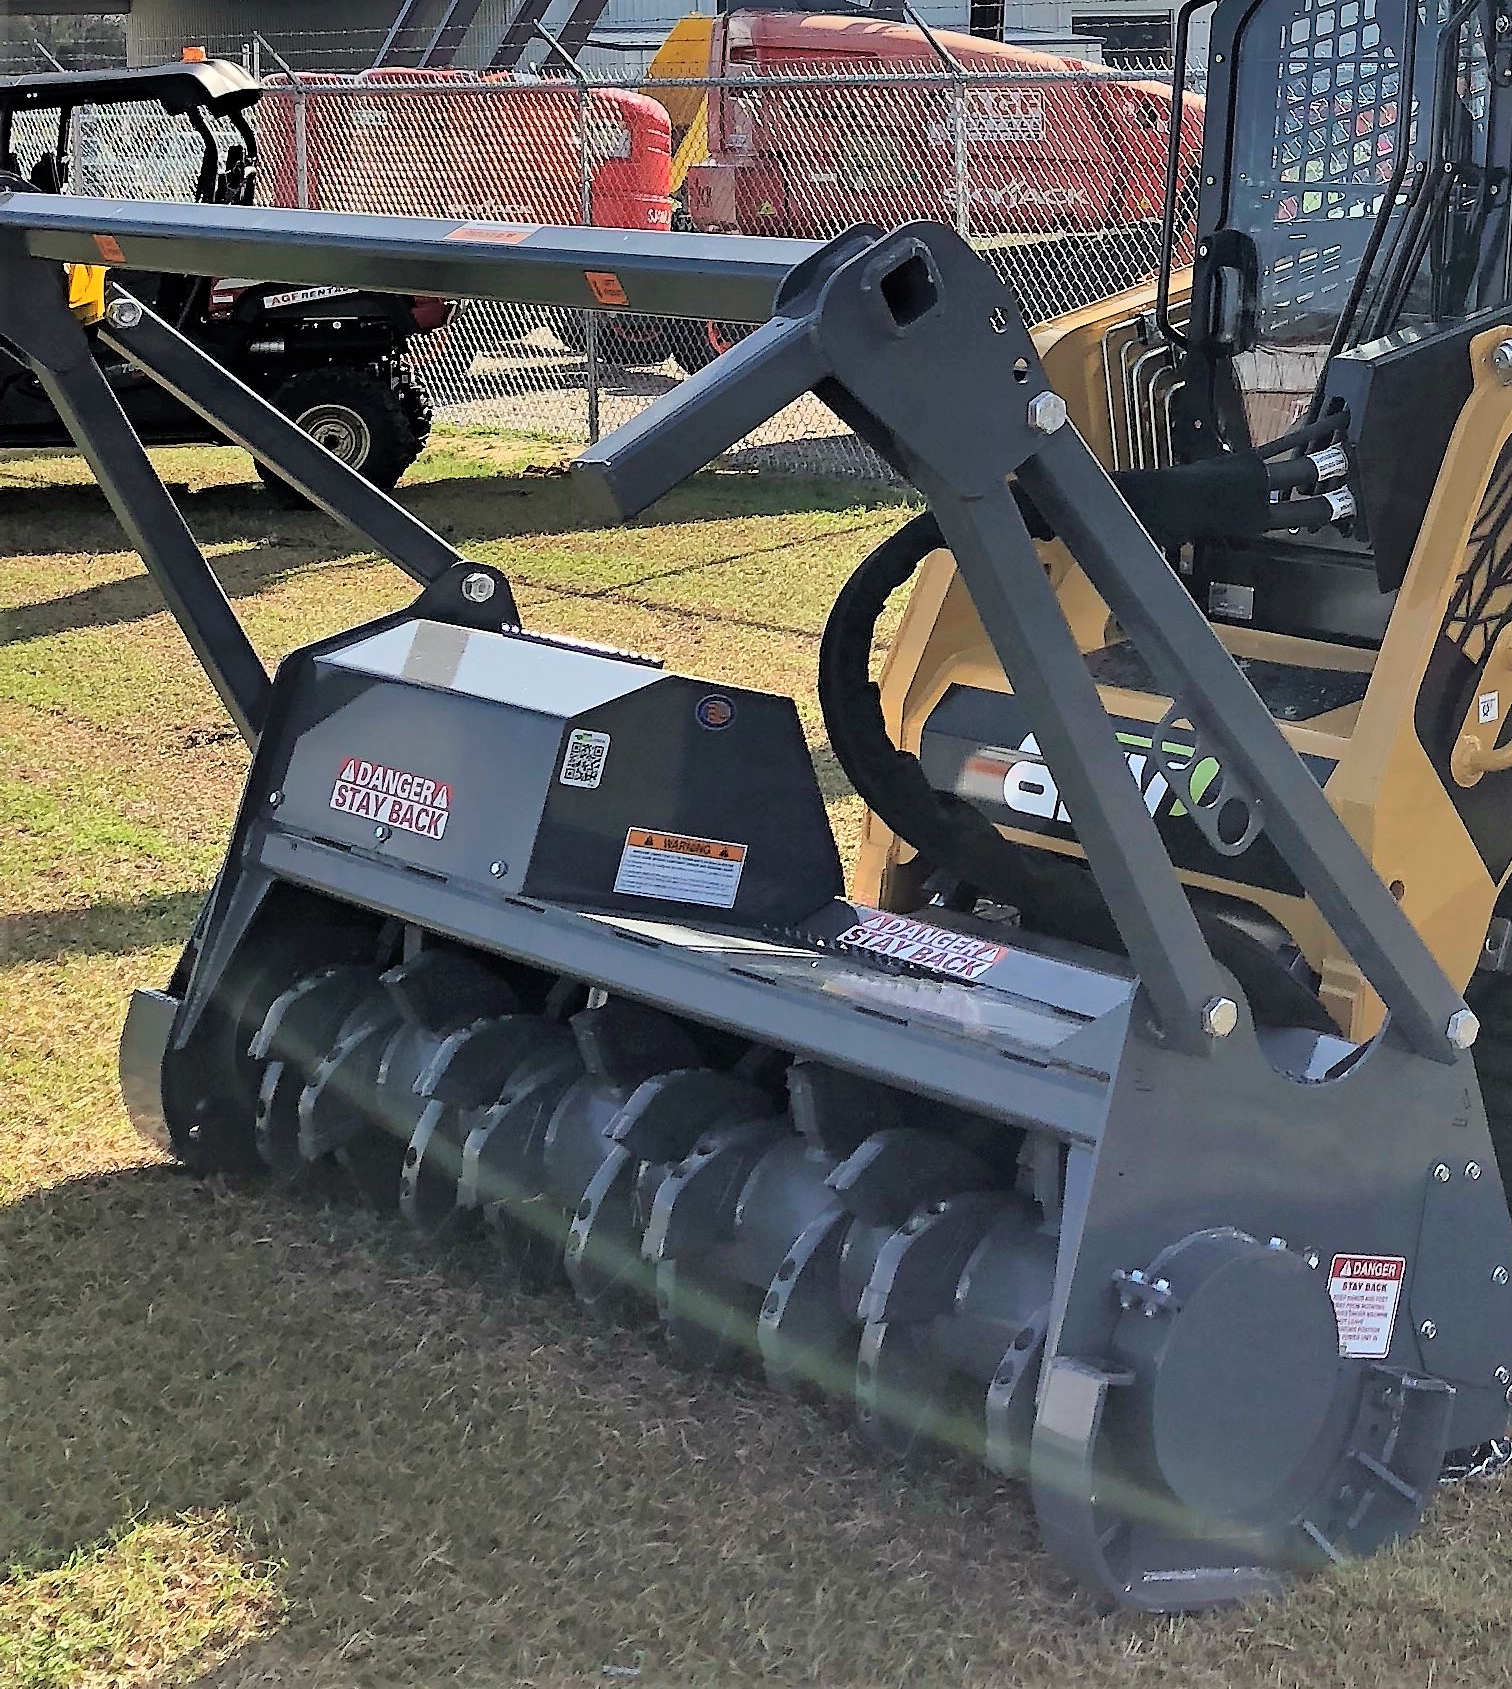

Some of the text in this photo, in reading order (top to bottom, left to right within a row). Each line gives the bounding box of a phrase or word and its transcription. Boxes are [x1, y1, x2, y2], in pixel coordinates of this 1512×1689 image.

[301, 285, 349, 301] RENT
[356, 761, 436, 805] DANGER
[336, 784, 444, 837] STAY BACK
[663, 838, 711, 855] WARNING
[844, 927, 986, 977] STAY BACK
[882, 918, 985, 959] DANGER
[1353, 1261, 1397, 1278] DANGER
[1342, 1281, 1388, 1292] STAY BACK
